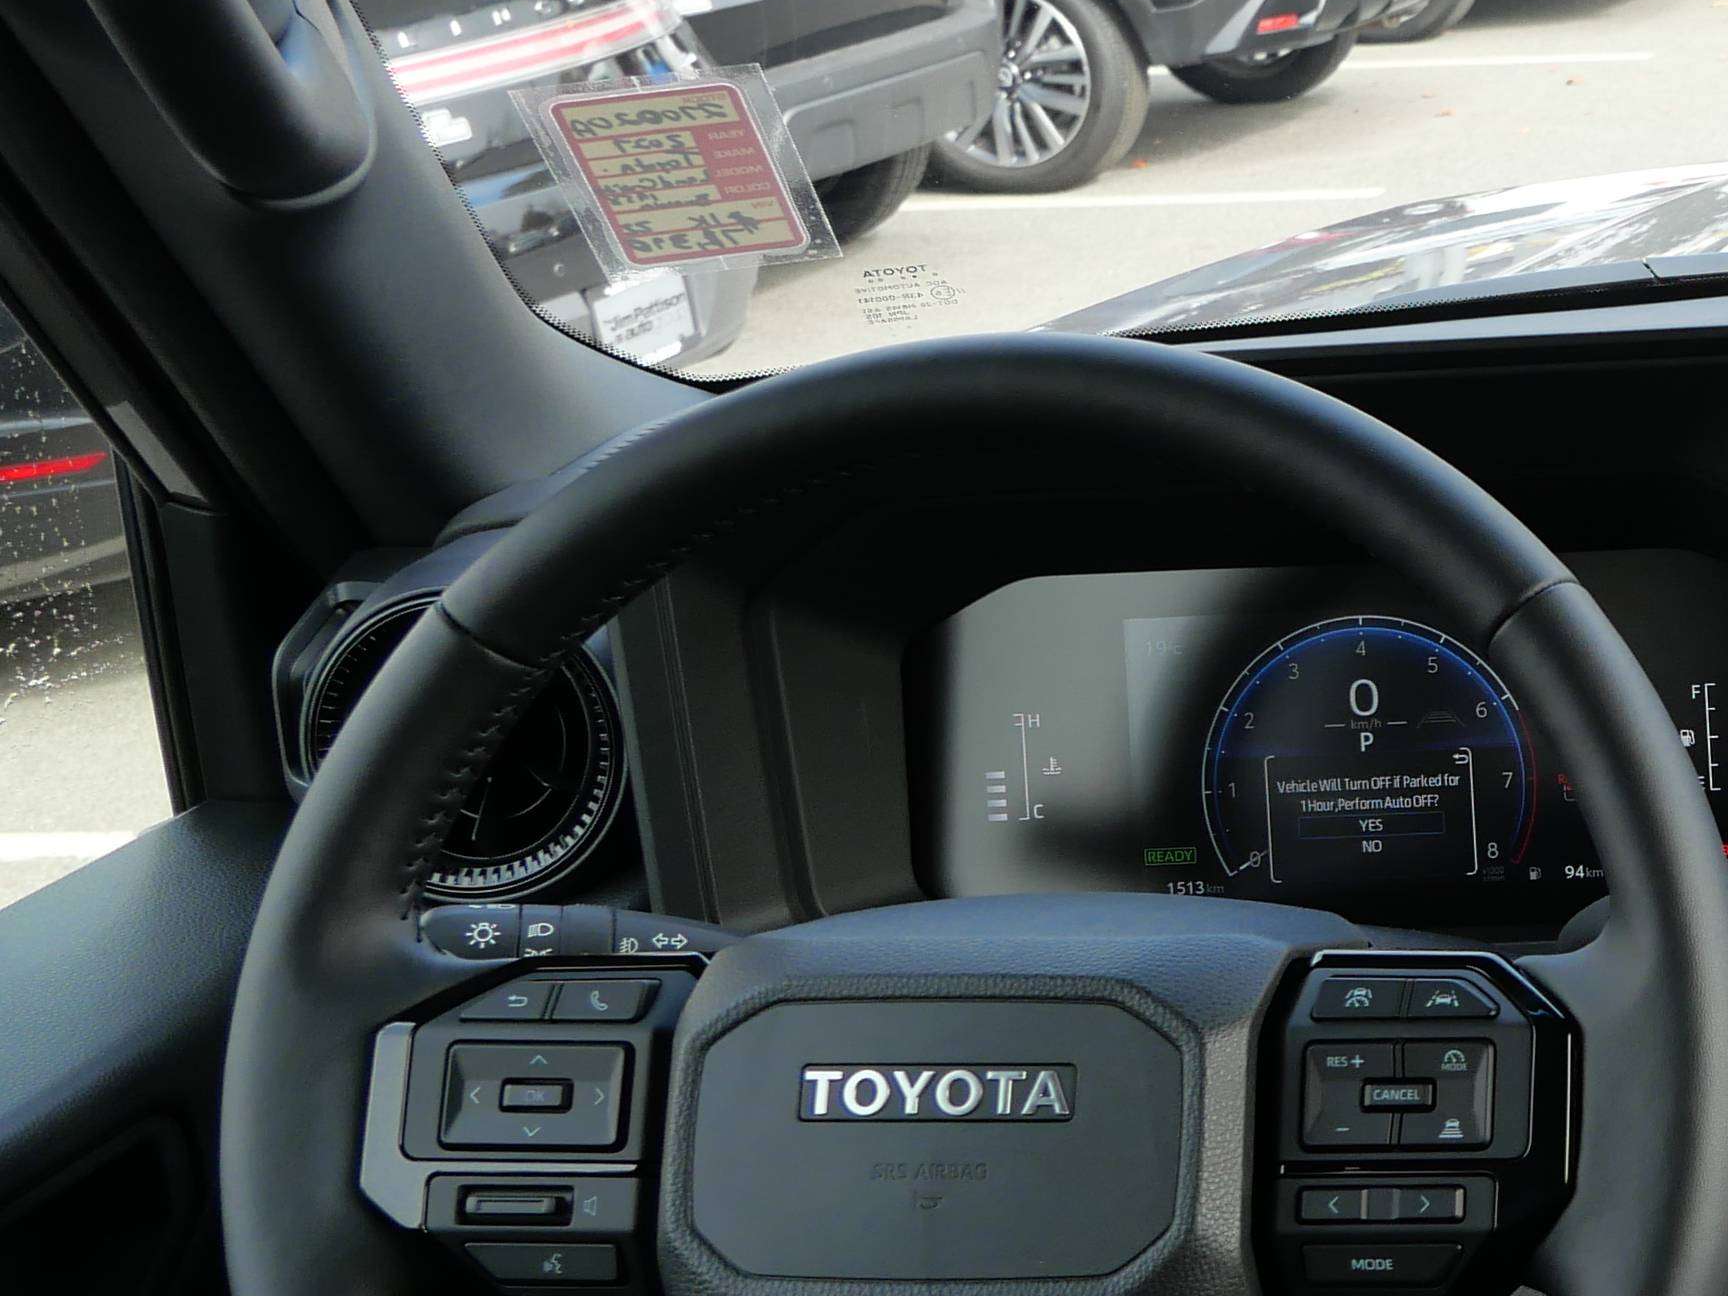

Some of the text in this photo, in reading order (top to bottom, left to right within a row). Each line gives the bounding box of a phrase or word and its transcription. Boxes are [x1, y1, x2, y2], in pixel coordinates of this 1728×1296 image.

[1355, 641, 1367, 657] 4
[1288, 663, 1300, 680] 3
[1427, 657, 1439, 673] 5
[1350, 679, 1379, 716] 0
[1691, 684, 1701, 699] F
[1475, 701, 1488, 718] 6
[1028, 713, 1041, 728] H
[1243, 713, 1255, 729] 2
[1350, 717, 1383, 729] km/h
[1360, 732, 1375, 752] P
[1277, 773, 1461, 794] Vehicle Will Turn OFF if Parked for
[1503, 772, 1513, 789] 7
[1229, 782, 1237, 799] 1
[1384, 796, 1412, 810] Auto
[1413, 795, 1440, 808] OFF?
[1033, 804, 1045, 819] C
[1359, 819, 1384, 832] YES
[1362, 840, 1383, 853] NO
[1487, 843, 1499, 859] 8
[1148, 849, 1194, 863] READY
[1249, 851, 1261, 867] 0
[1564, 865, 1604, 879] 94 km
[1166, 881, 1225, 895] 1513 km
[1326, 1056, 1348, 1067] RES
[1440, 1063, 1467, 1072] MODE
[803, 1069, 1070, 1116] TOYOTA
[1373, 1089, 1420, 1101] CANCEL
[869, 1161, 989, 1182] SRS AIRBAG
[1351, 1259, 1394, 1271] MODE
